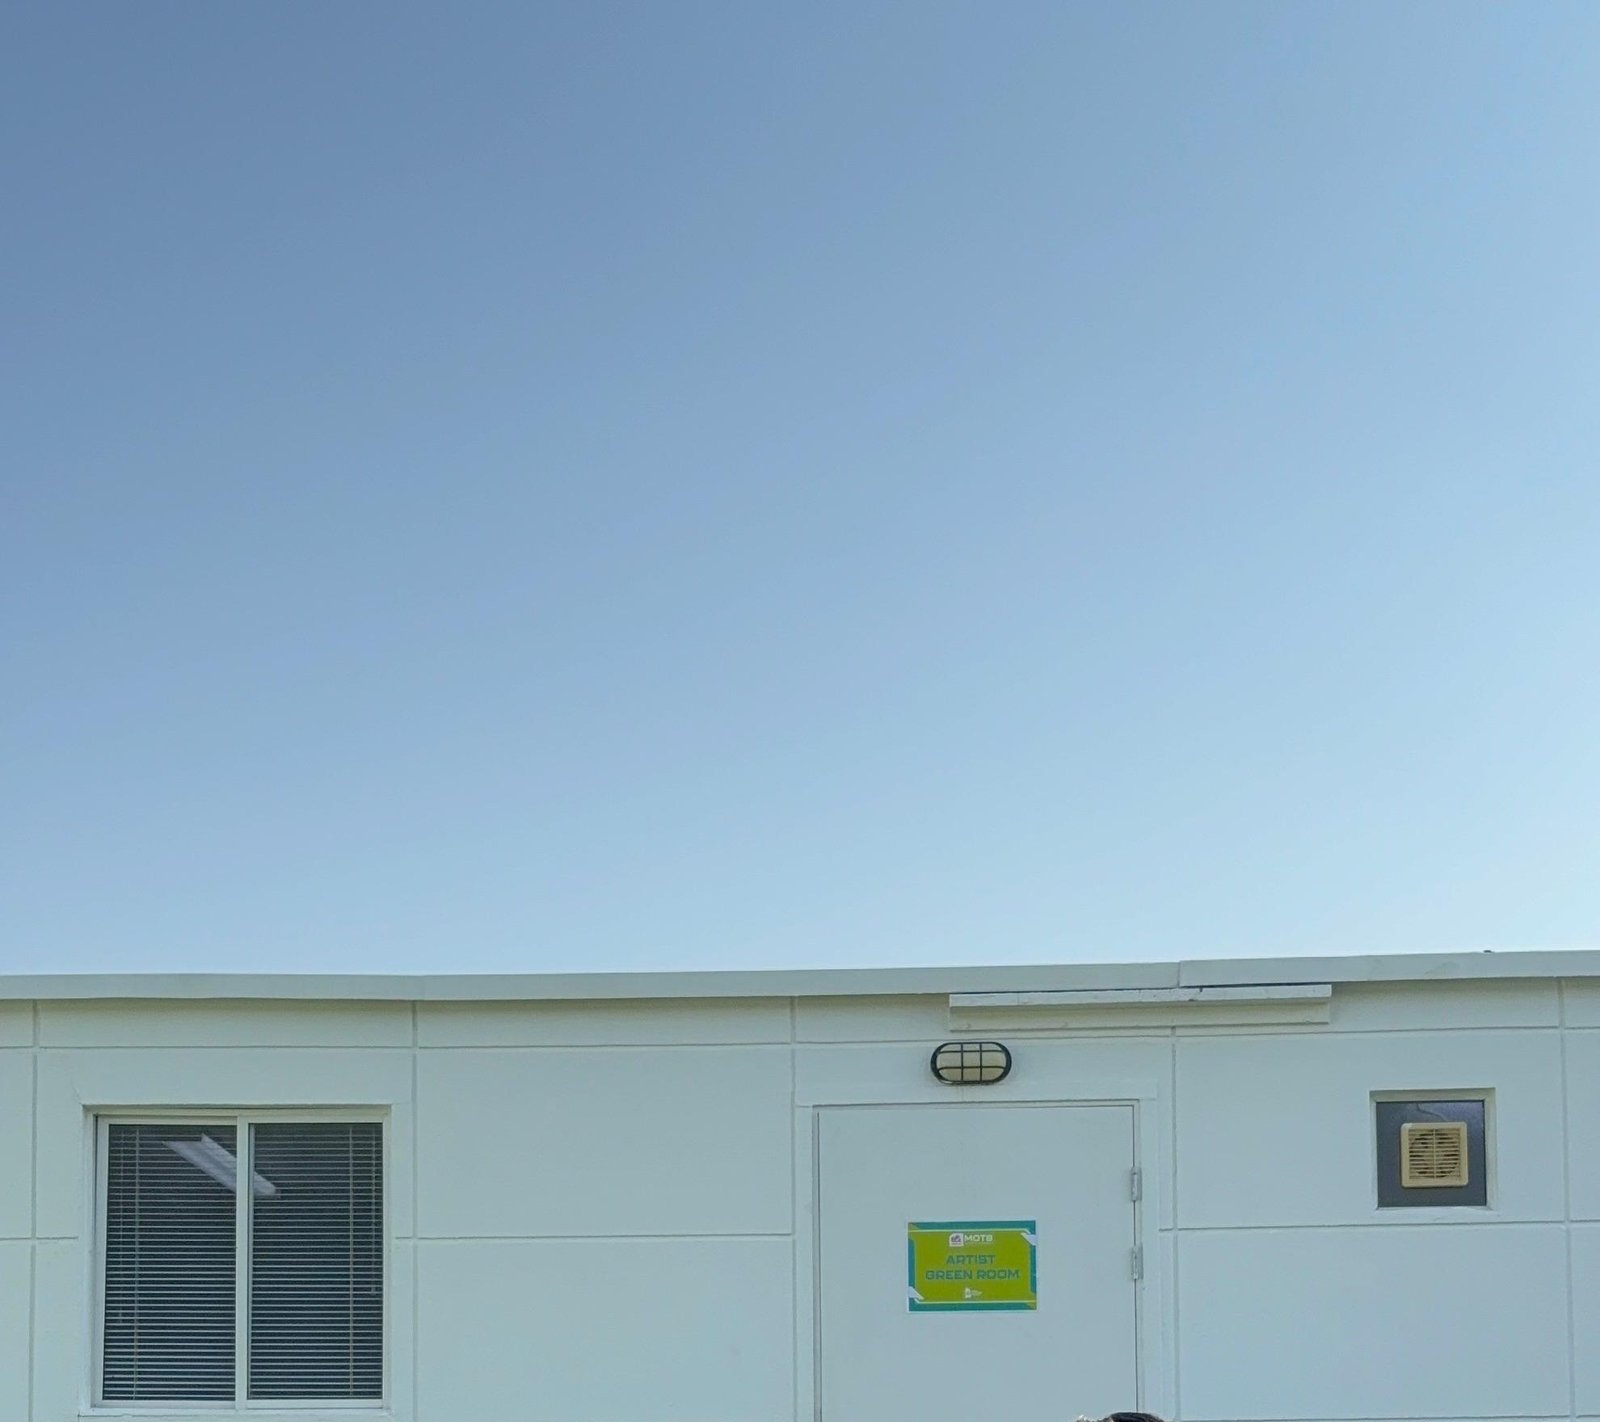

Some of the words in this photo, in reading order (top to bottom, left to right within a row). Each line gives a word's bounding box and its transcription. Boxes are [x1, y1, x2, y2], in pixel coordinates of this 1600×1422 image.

[946, 1254, 996, 1265] ARTIST
[925, 1270, 973, 1280] GREEN
[976, 1269, 1020, 1280] ROOM
